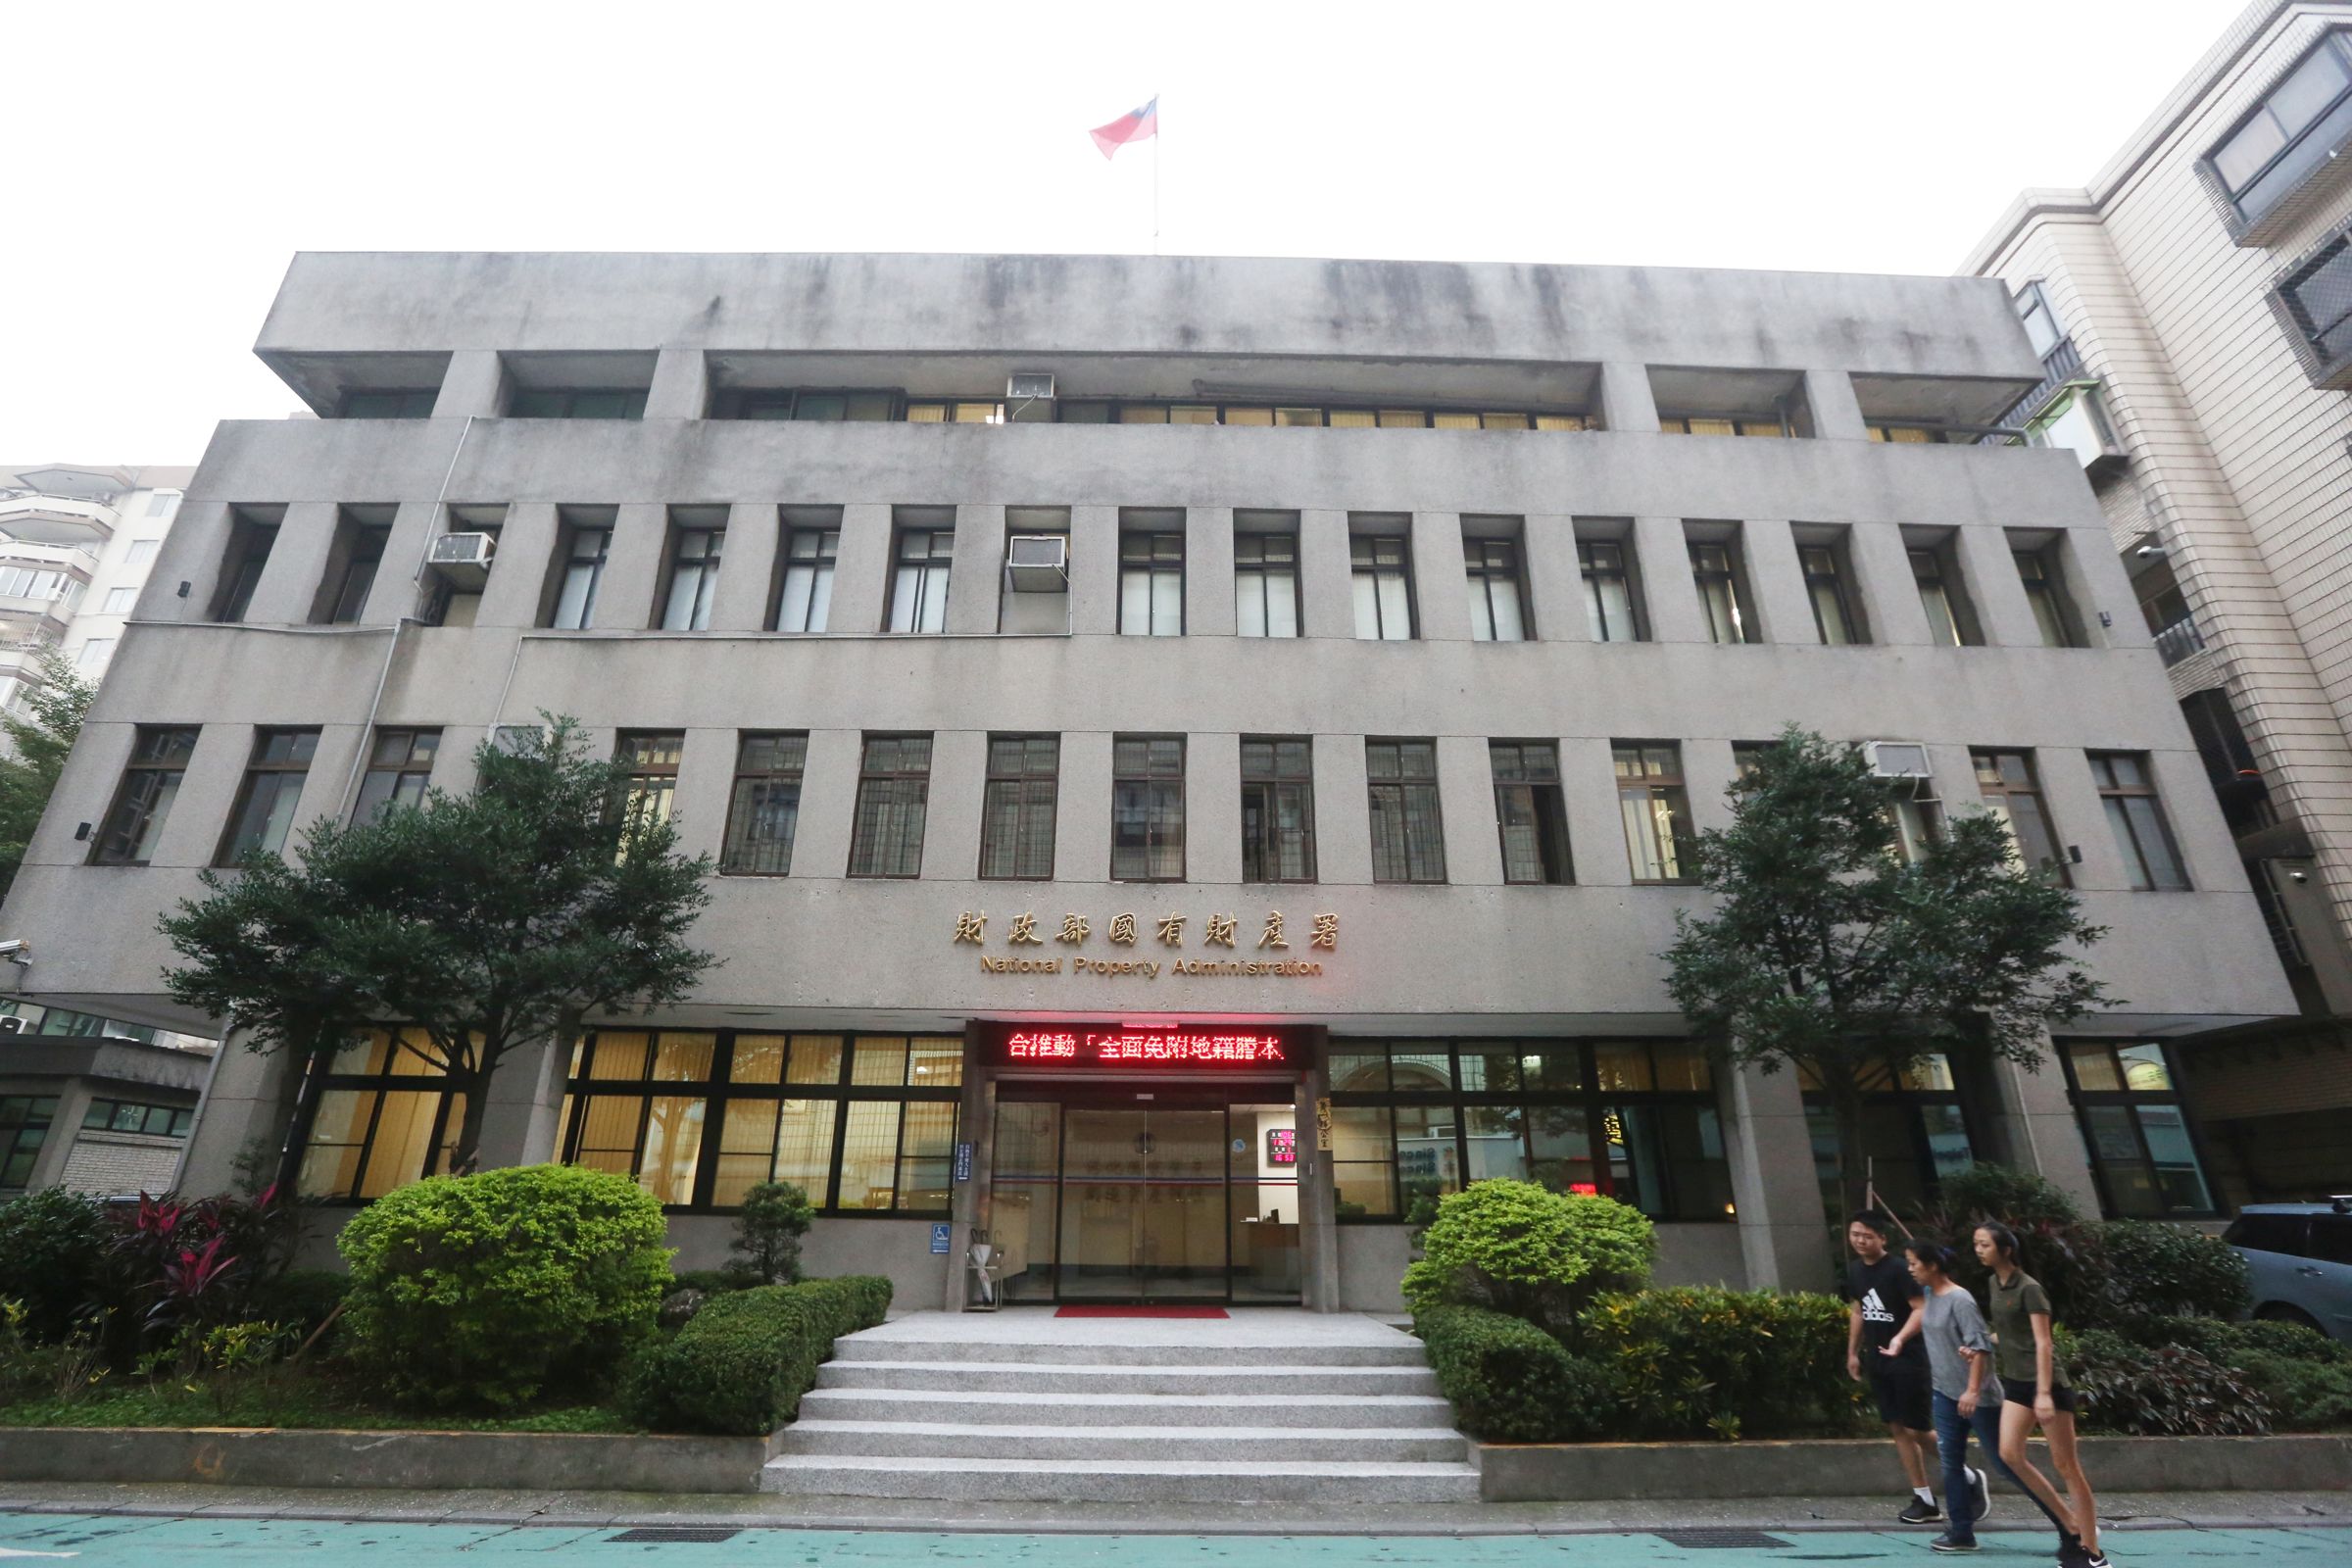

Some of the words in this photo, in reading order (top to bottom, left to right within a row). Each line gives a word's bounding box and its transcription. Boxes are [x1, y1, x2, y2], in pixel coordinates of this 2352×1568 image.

[954, 909, 1339, 952] 財政部國有財產署
[981, 956, 1063, 973] National
[1074, 957, 1160, 978] Property
[1171, 957, 1323, 976] Administration
[1862, 1309, 1895, 1322] didas
